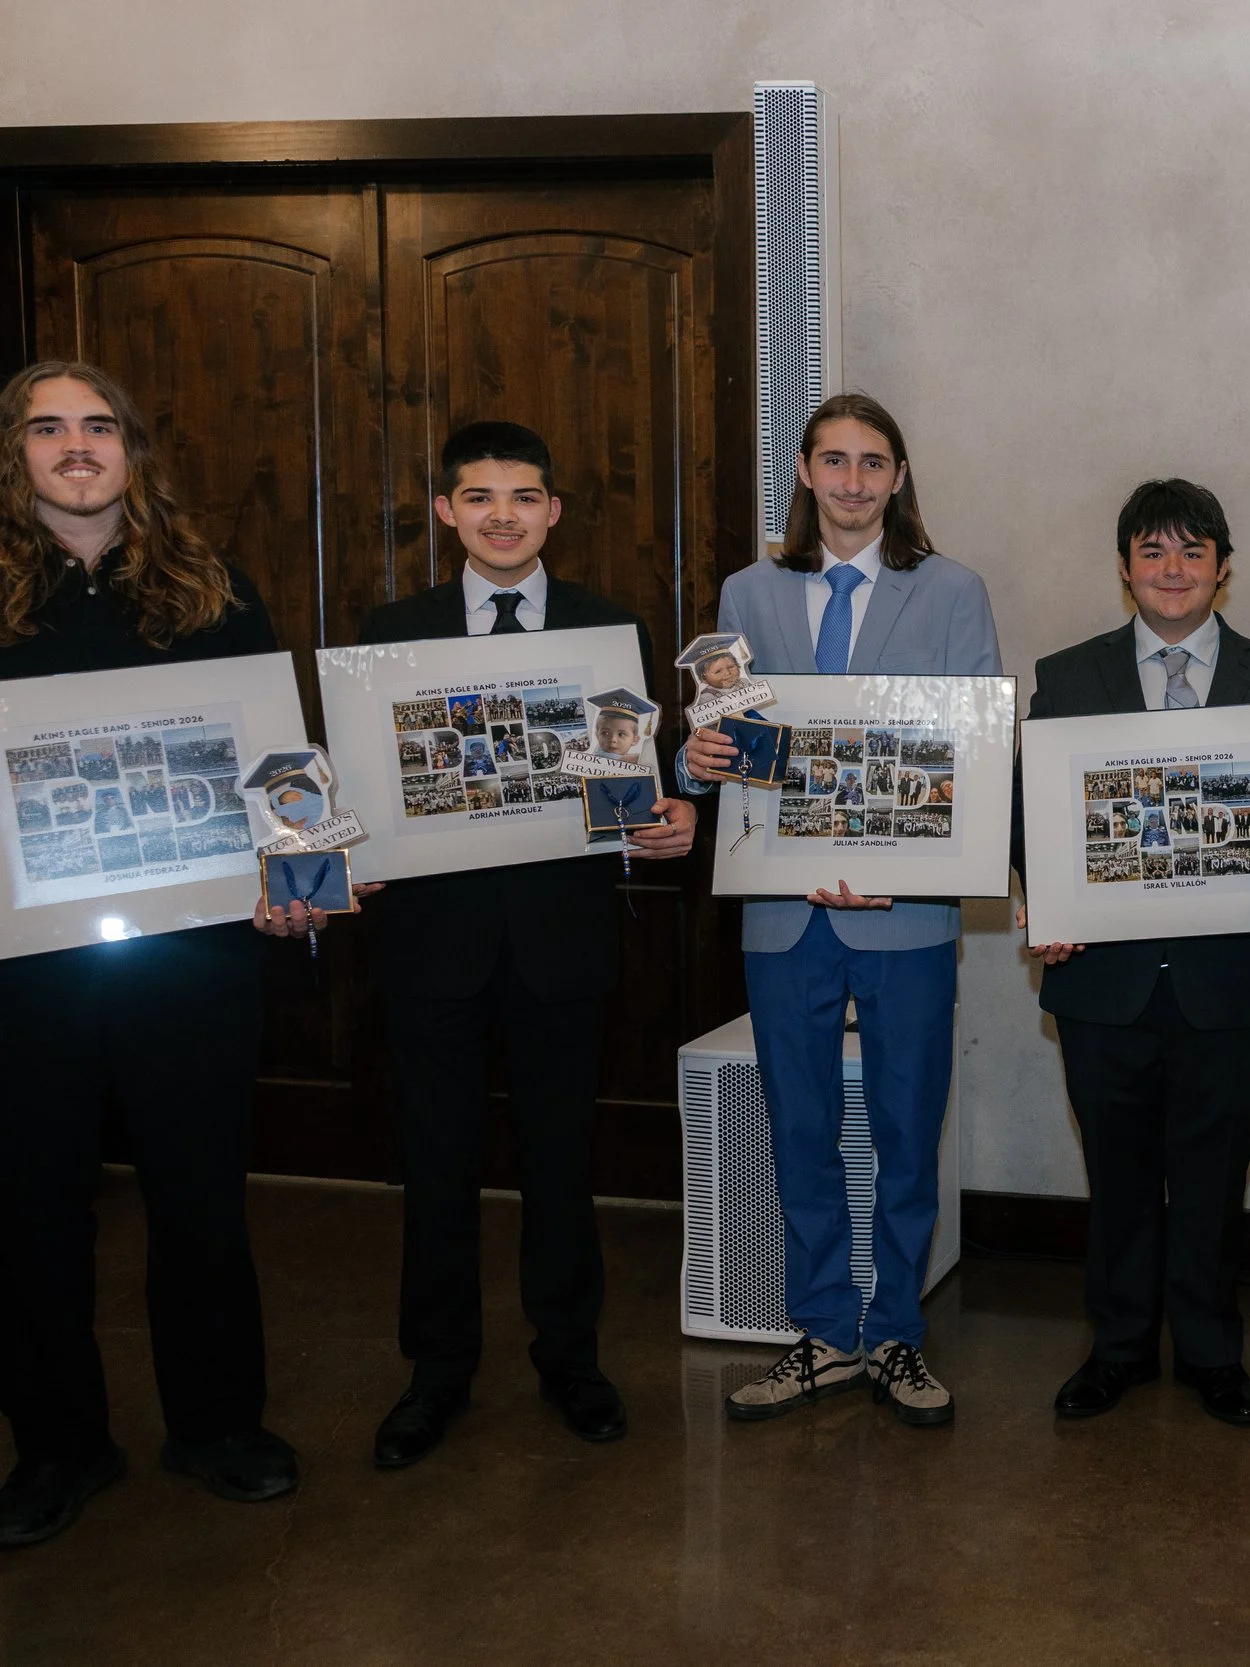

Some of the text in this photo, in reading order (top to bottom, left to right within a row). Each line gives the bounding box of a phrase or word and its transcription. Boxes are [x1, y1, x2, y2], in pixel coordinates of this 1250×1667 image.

[416, 688, 442, 696] AKINS
[444, 685, 471, 694] EAGLE
[474, 683, 497, 691] BAND
[506, 680, 534, 689] SENIOR
[612, 700, 632, 709] 2026
[691, 683, 764, 714] LOOK WHO'S
[696, 692, 768, 723] GRADUATED
[33, 731, 66, 741] AKINS
[68, 728, 101, 737] EAGLE
[102, 724, 130, 733] BAND
[141, 719, 176, 729] SENIOR
[179, 715, 204, 724] 2026
[567, 751, 647, 774] LOOK WHO'S
[1156, 756, 1178, 764] BAND
[1185, 754, 1212, 762] SENIOR
[269, 764, 293, 777] 2026
[469, 806, 542, 820] ADRIAN MÁRQUEZ
[305, 812, 352, 836] WHO'S
[144, 865, 189, 876] PEDRAZA
[1144, 879, 1206, 890] ISRAEL VILLALÓN
